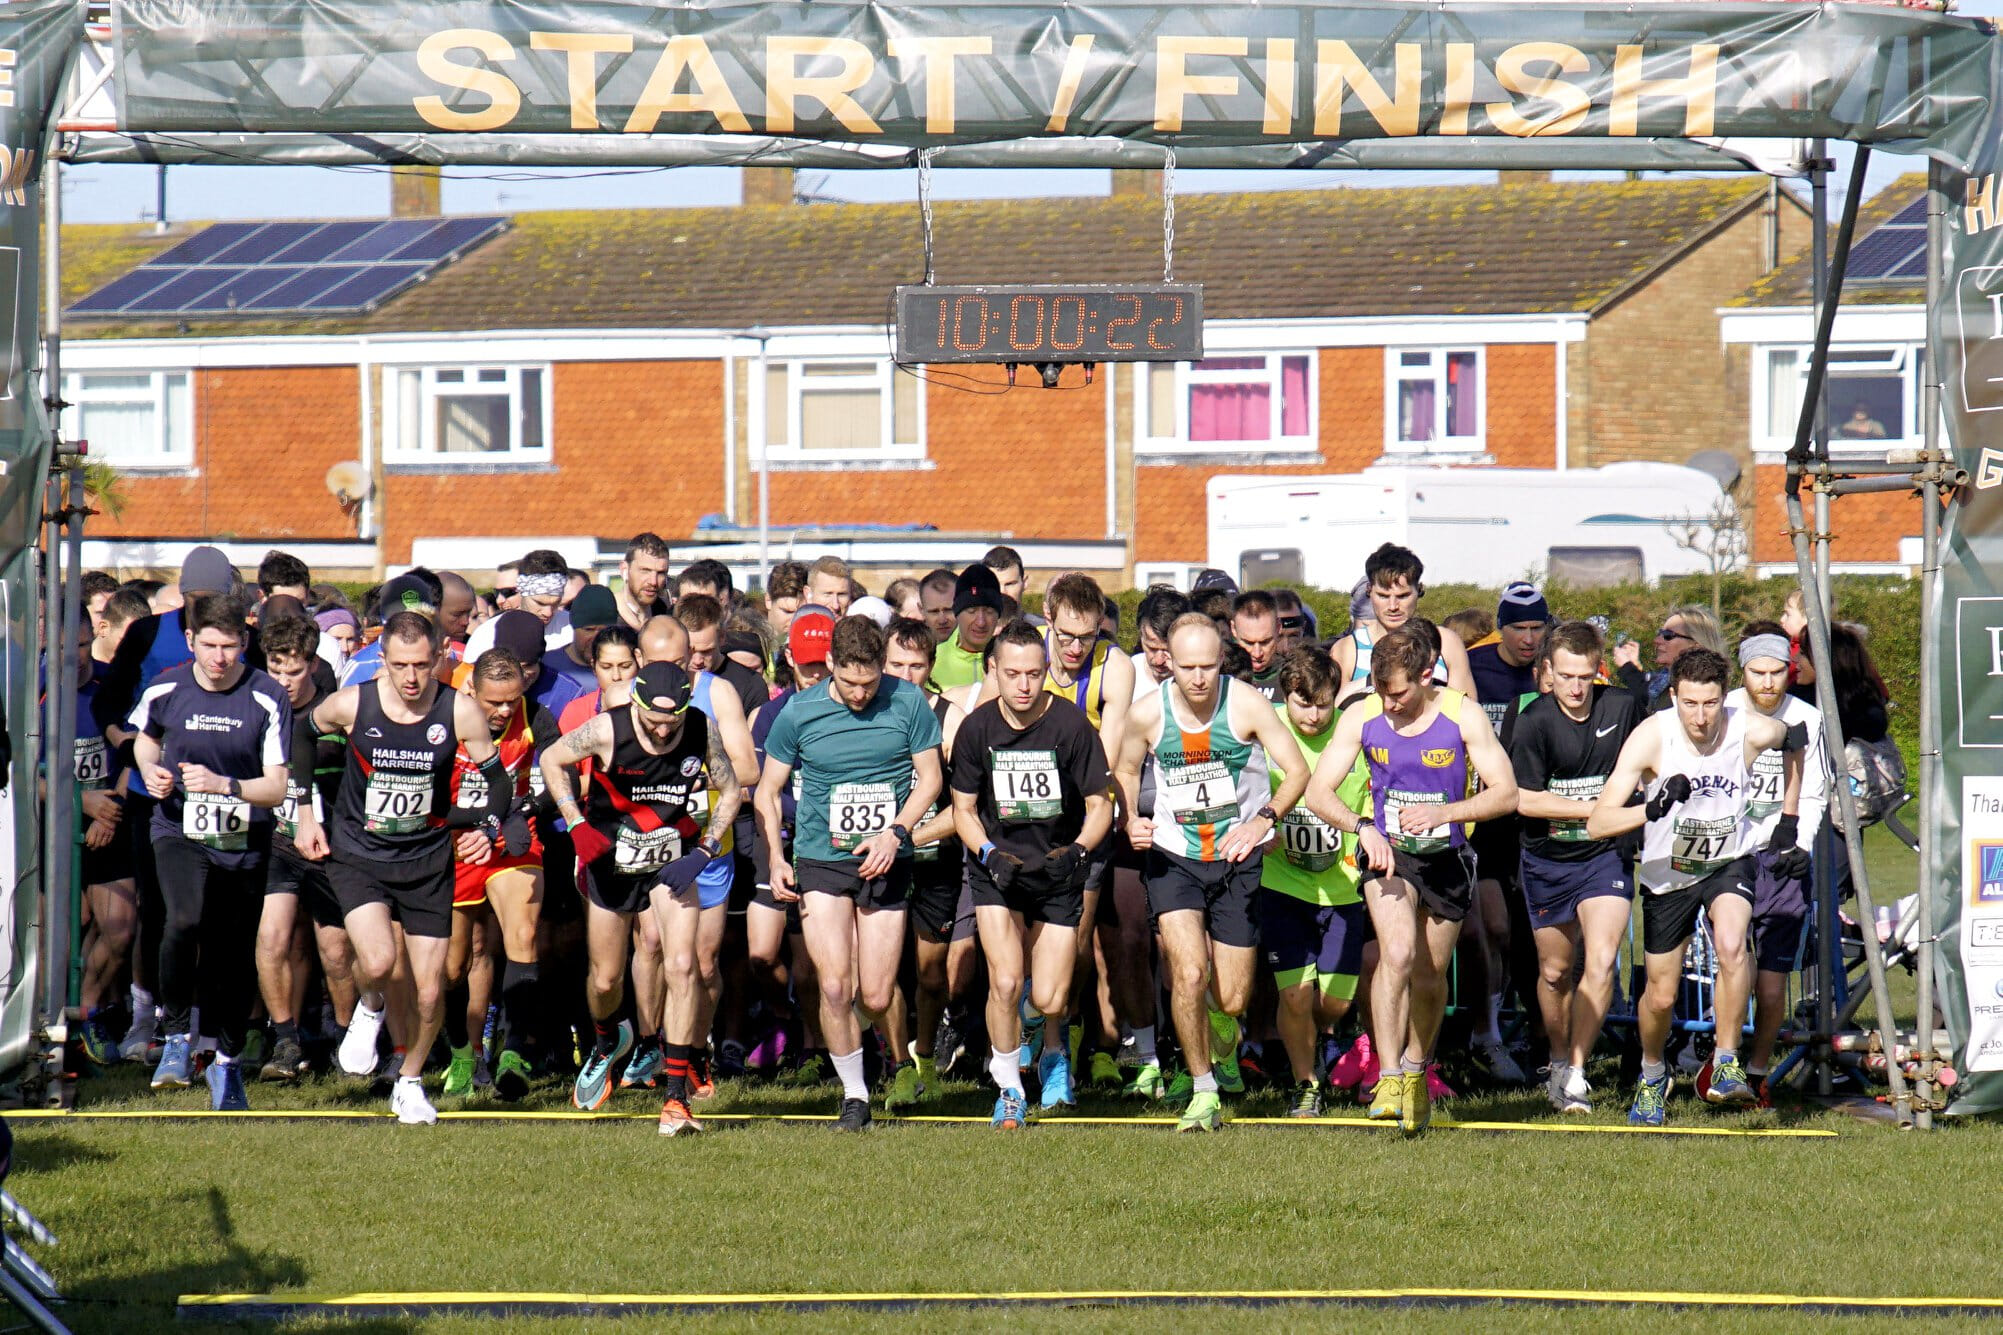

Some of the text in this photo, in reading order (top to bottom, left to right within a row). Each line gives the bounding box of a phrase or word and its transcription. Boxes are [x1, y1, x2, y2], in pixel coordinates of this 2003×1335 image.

[411, 28, 993, 135] START
[1153, 35, 1720, 138] FINISH
[937, 294, 1184, 351] 10:00:22
[199, 722, 231, 732] Harriers
[200, 714, 243, 728] Canterbury
[372, 748, 434, 762] HAILSHAM
[996, 751, 1052, 762] EASTBOURNE
[1163, 750, 1232, 759] MORNINGTON
[74, 753, 102, 779] 69
[372, 759, 432, 771] HARRIERS
[994, 761, 1055, 771] HALF MARATHON
[1169, 760, 1226, 777] EASTBOURNE
[373, 773, 431, 785] EASTBOURNE
[1167, 767, 1230, 786] HALF MARATHON
[632, 784, 687, 795] HAILSHAM
[835, 783, 891, 794] EASTBOURNE
[1007, 772, 1051, 799] 148
[1691, 774, 1739, 798] OENIX
[631, 794, 686, 806] HARRIERS
[855, 792, 895, 803] MARATHON
[1195, 783, 1211, 808] 4
[1387, 790, 1444, 802] EASTBOURNE
[377, 791, 425, 817] 702
[195, 803, 241, 833] 816
[840, 804, 886, 832] 835
[1679, 817, 1734, 830] ASTBOURNE
[1286, 825, 1339, 853] 1013
[628, 843, 673, 866] 746
[1682, 836, 1729, 860] 747
